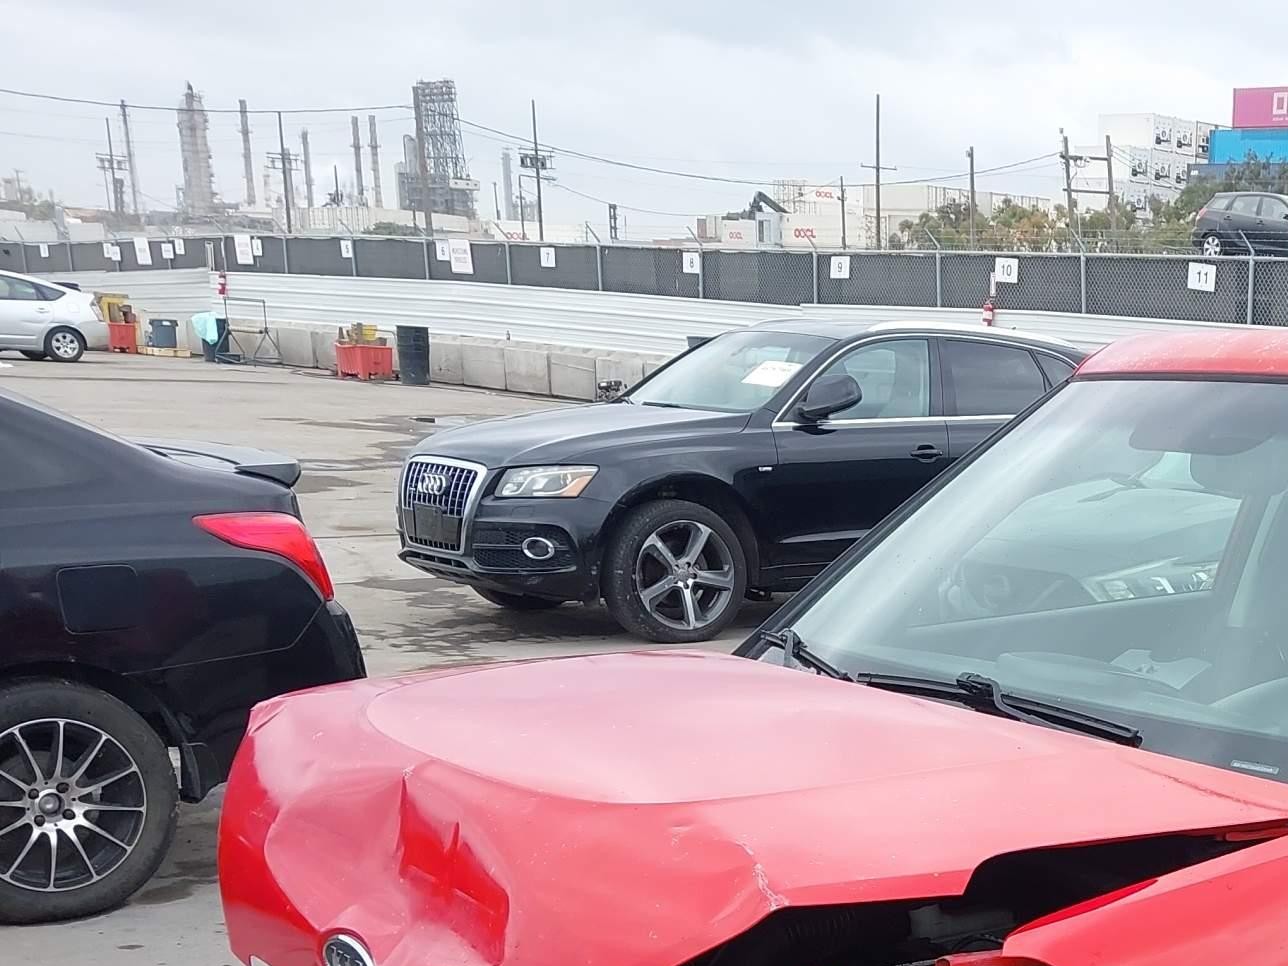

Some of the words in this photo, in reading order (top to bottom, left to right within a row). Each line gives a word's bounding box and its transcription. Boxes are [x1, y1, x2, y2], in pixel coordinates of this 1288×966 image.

[837, 262, 843, 273] 9
[1001, 263, 1012, 277] 10
[1196, 269, 1209, 285] 11
